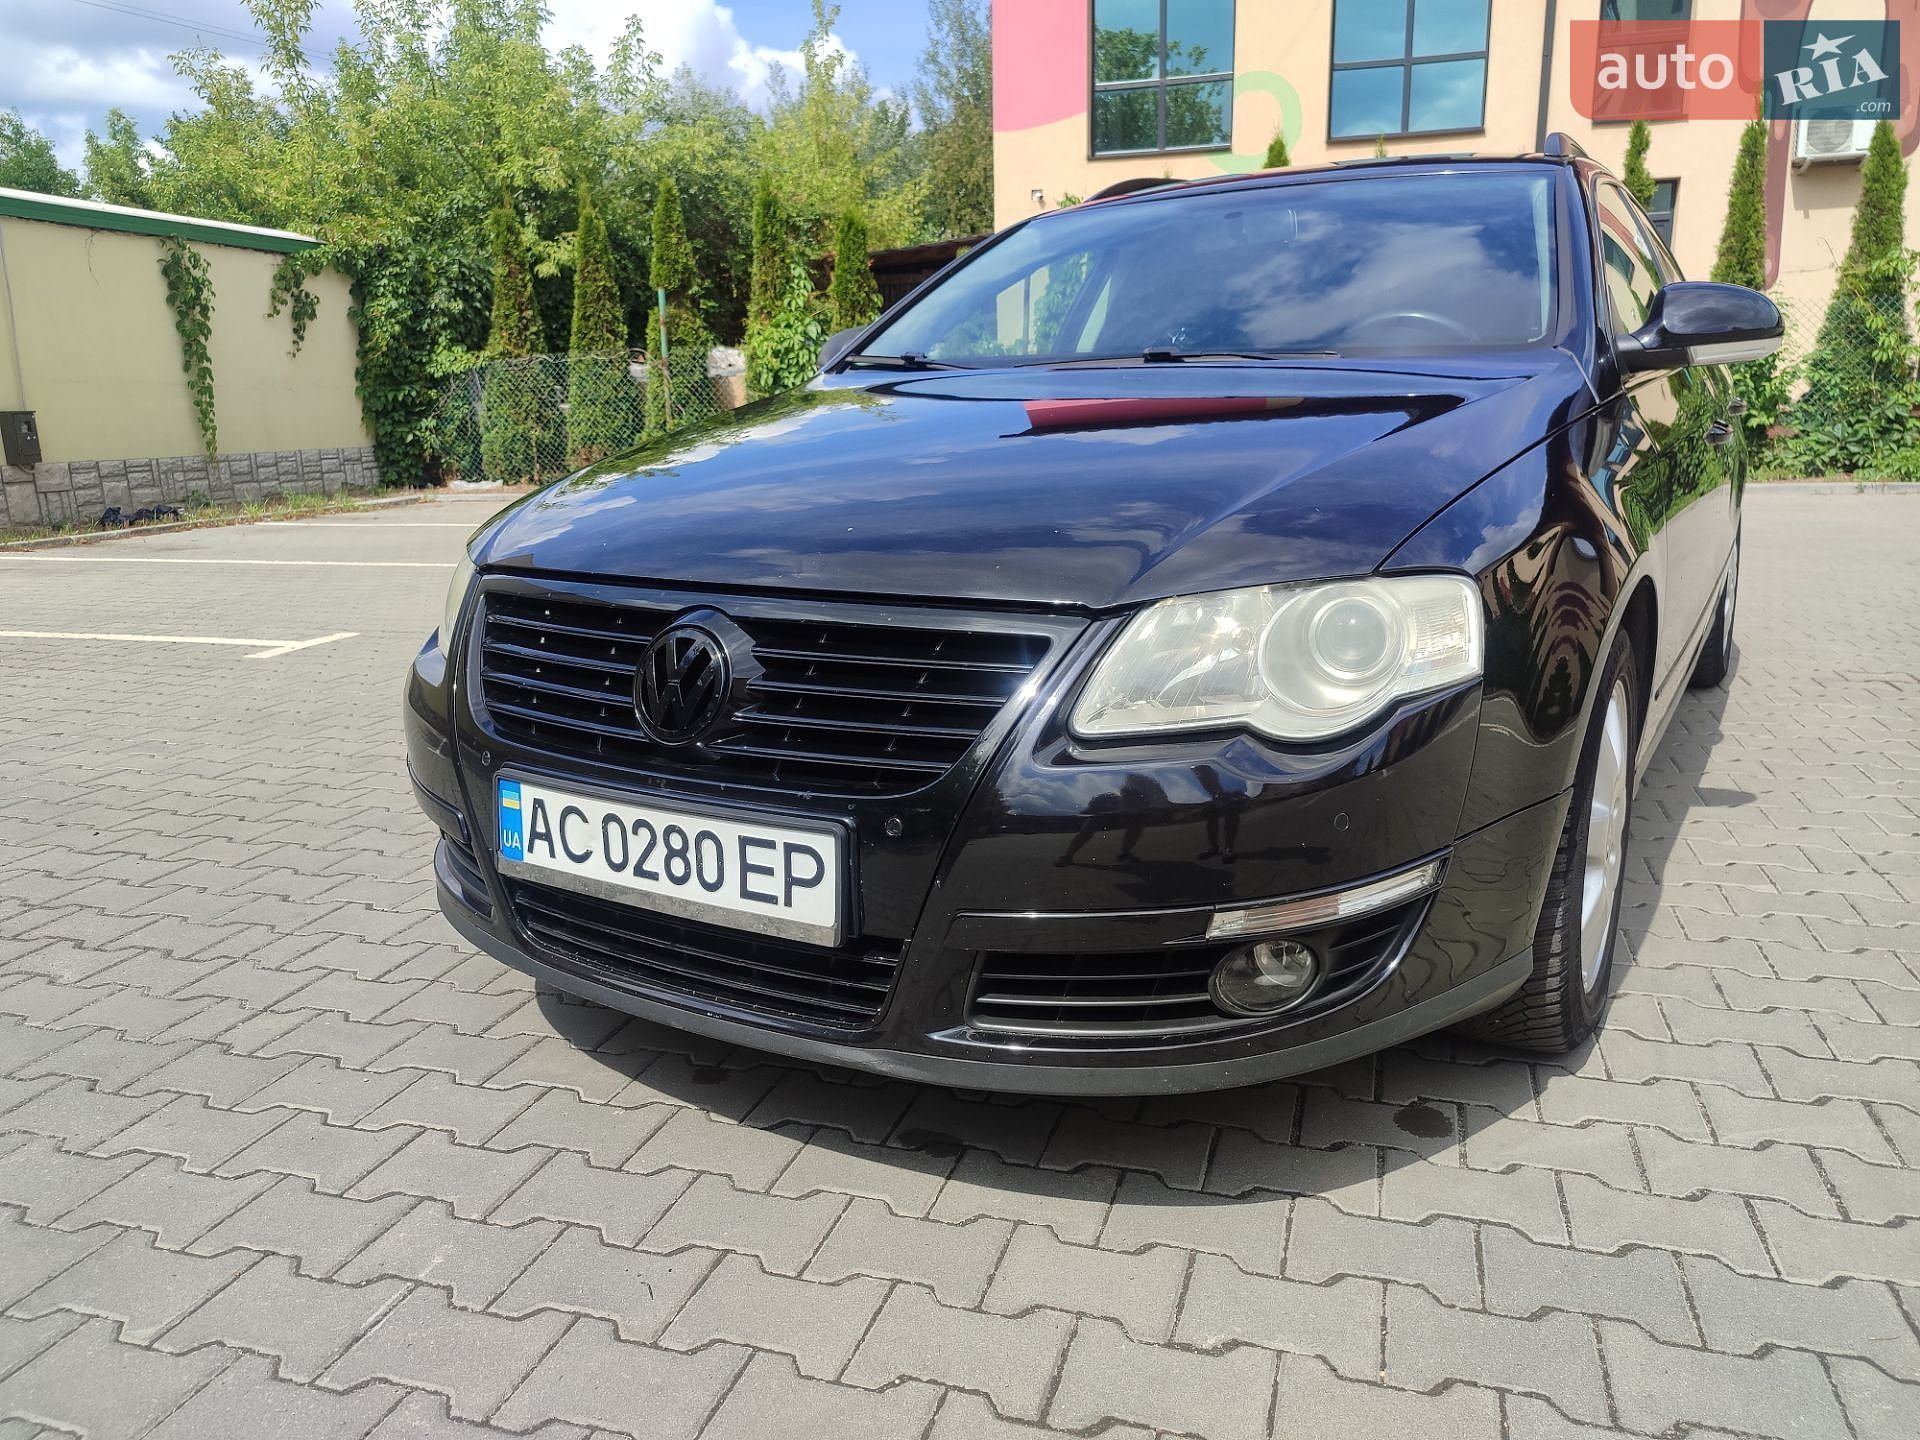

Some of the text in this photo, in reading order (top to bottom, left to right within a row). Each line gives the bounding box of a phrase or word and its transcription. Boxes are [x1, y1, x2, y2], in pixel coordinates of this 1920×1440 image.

[503, 829, 521, 850] UA
[527, 797, 826, 908] AC 0280 EP
